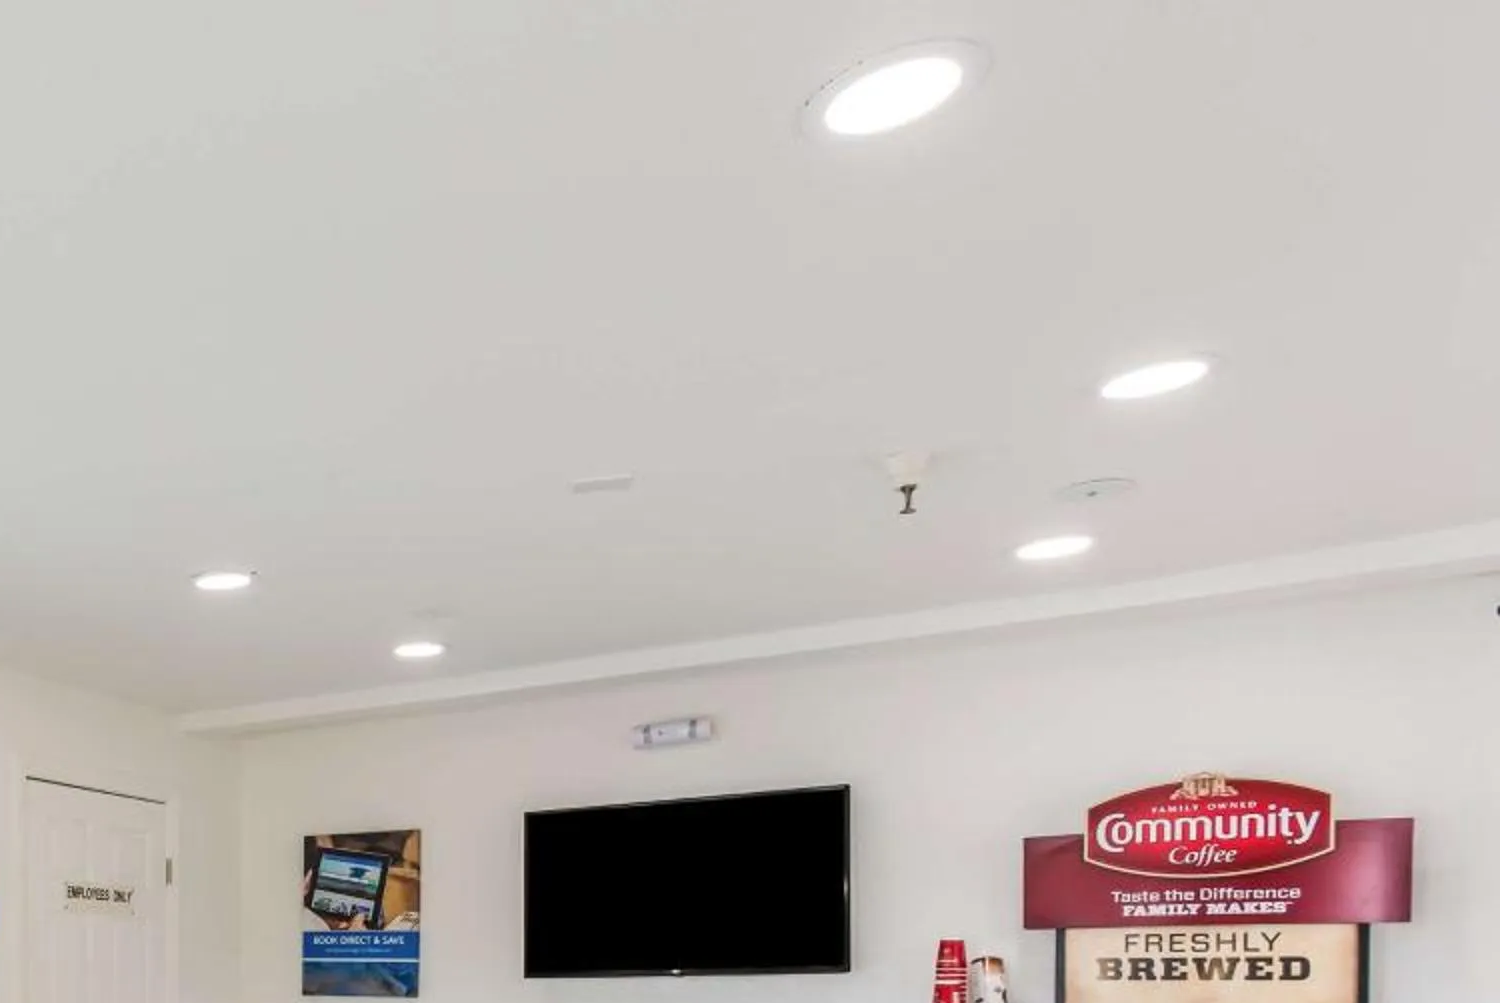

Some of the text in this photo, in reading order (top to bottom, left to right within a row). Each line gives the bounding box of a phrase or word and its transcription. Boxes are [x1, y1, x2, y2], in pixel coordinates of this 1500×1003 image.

[1151, 800, 1257, 814] FAMILY OWNED
[1096, 804, 1321, 853] Community
[1168, 843, 1238, 867] Coffee
[1110, 886, 1302, 903] Taste the Difference
[1122, 903, 1200, 917] FAMILY
[313, 935, 339, 945] BOOK
[382, 935, 405, 945] SAVE
[1124, 931, 1282, 953] FRESHLY
[1096, 956, 1312, 981] BREWED
